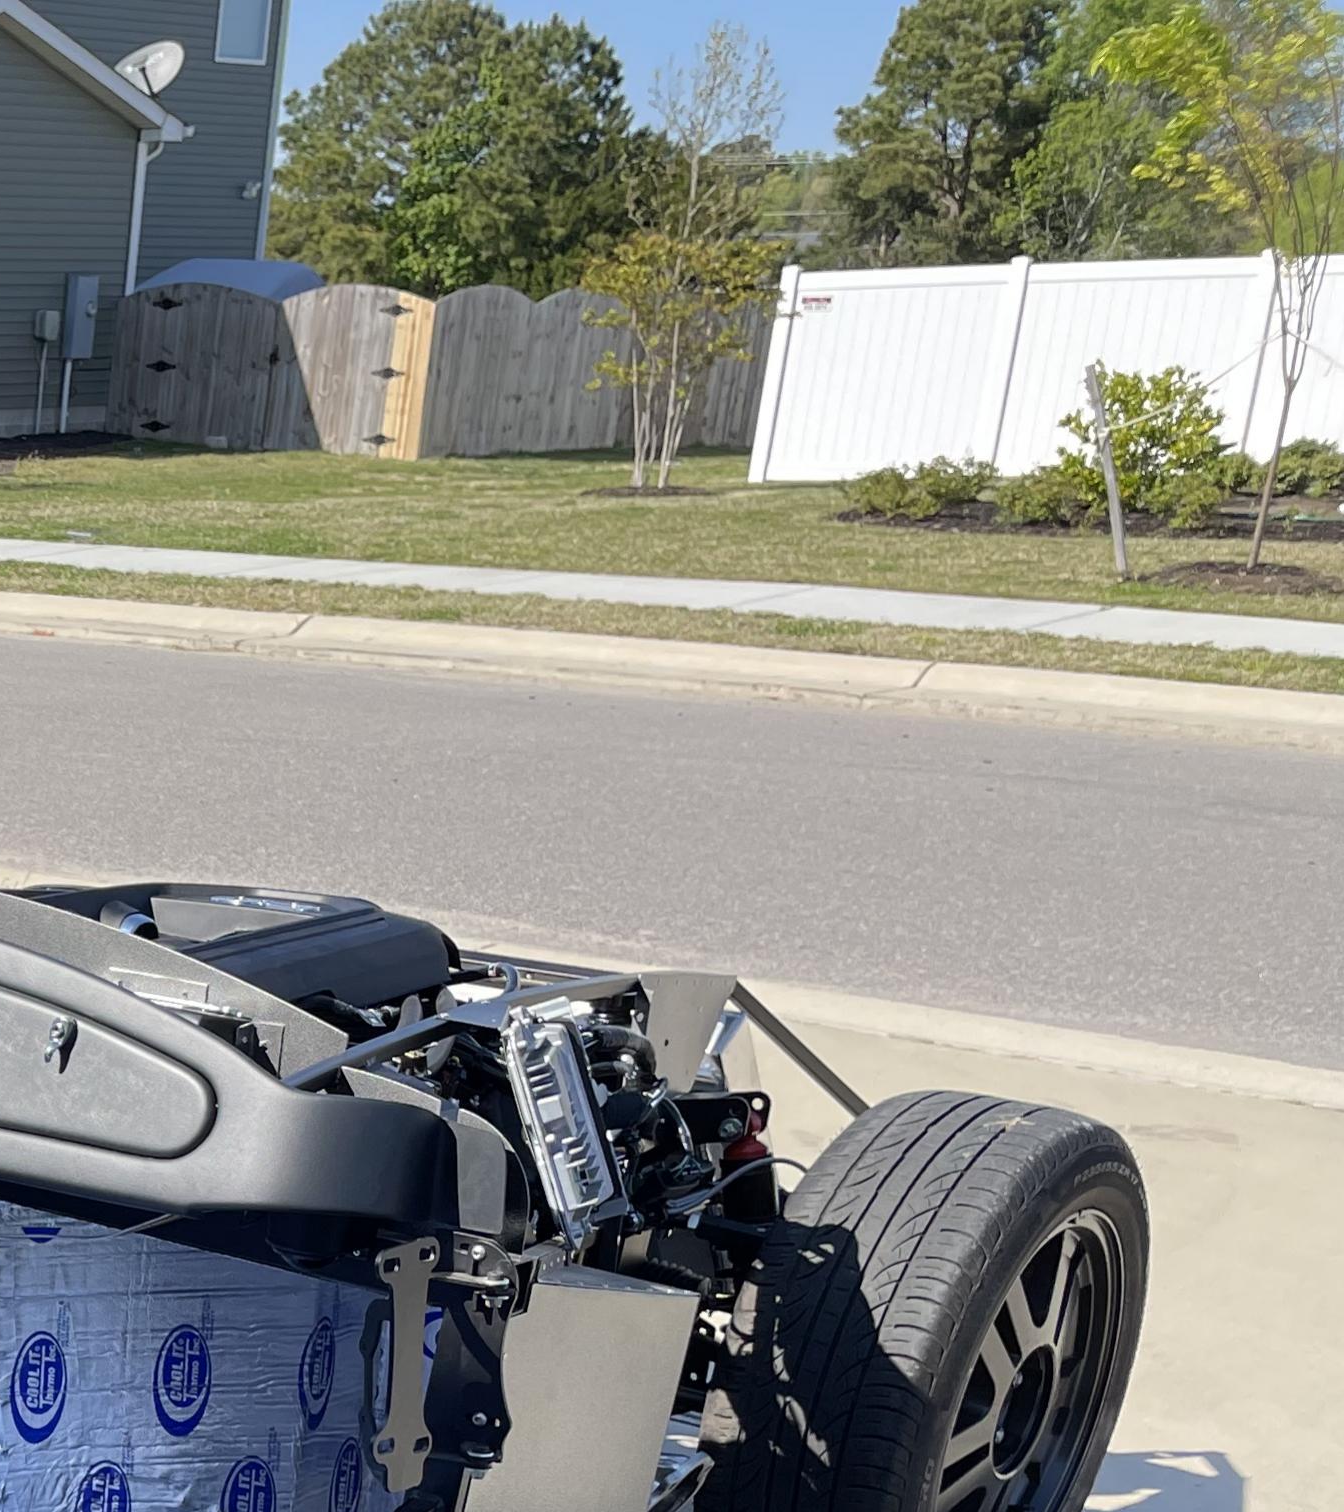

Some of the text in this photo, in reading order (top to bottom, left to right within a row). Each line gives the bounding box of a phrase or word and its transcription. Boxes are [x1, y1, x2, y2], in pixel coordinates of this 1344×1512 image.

[26, 1349, 41, 1409] COOL IT
[41, 1366, 56, 1405] Thermo
[169, 1342, 185, 1402] COOL IT
[185, 1361, 200, 1400] Thermo
[91, 1476, 106, 1492] IT
[237, 1472, 251, 1490] IT
